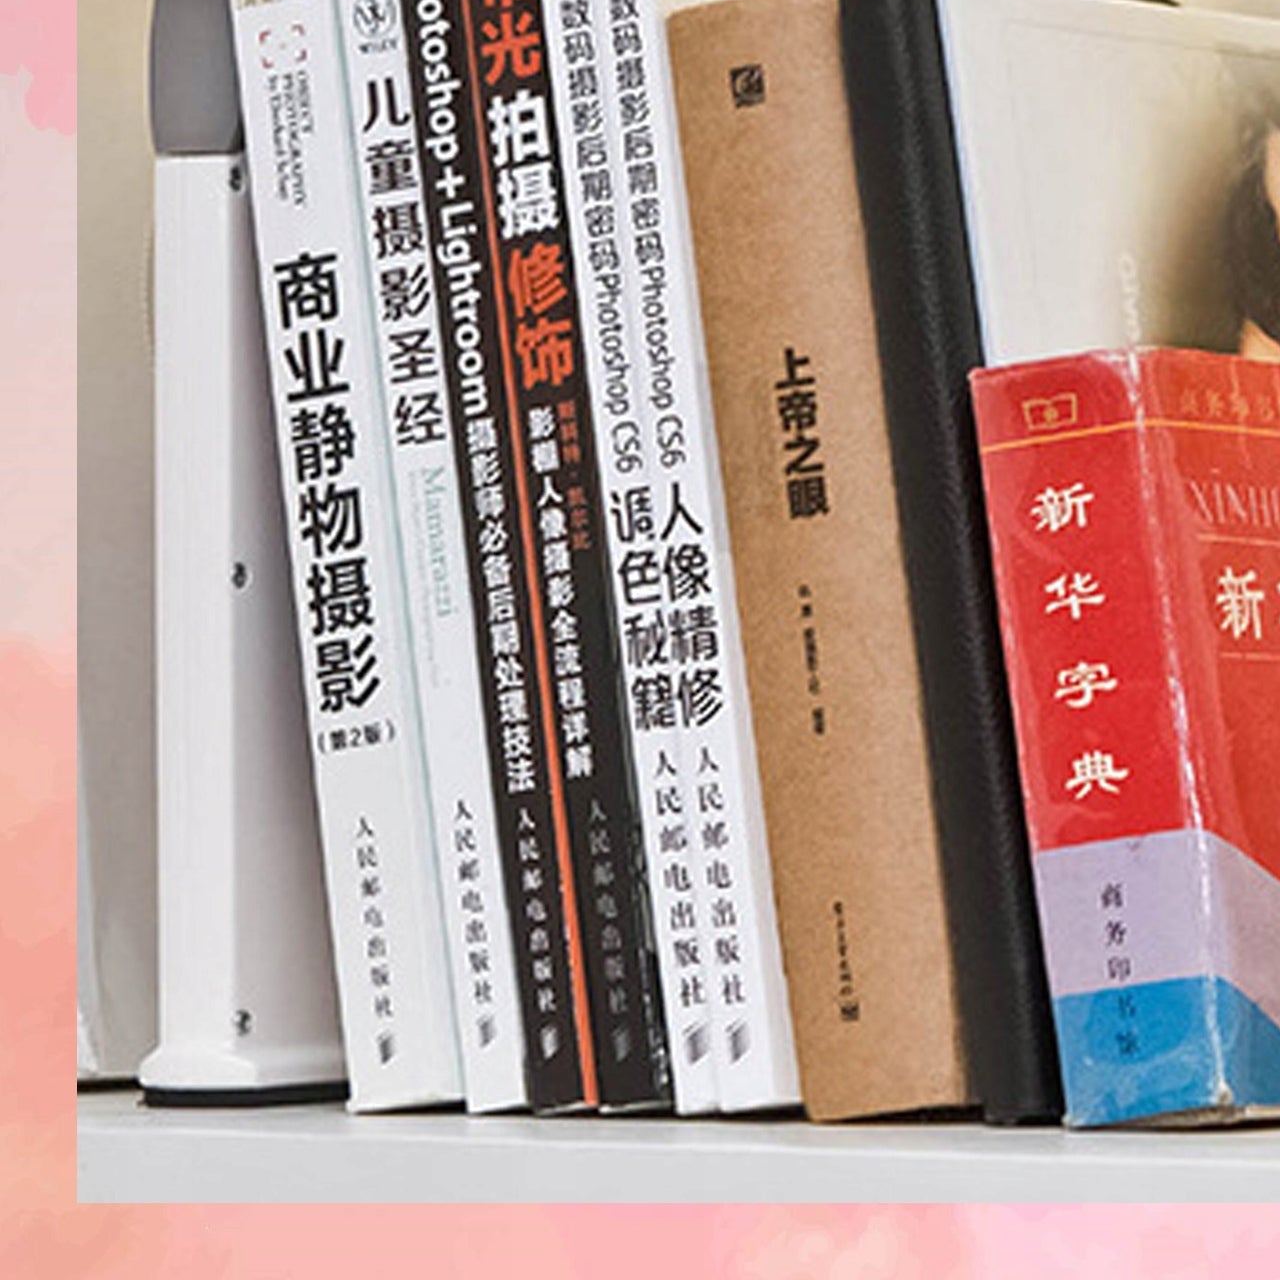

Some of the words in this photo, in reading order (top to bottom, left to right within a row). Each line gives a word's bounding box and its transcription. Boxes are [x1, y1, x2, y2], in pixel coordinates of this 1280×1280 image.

[363, 76, 446, 447] 儿童摄影圣经
[273, 251, 380, 713] 商业静物摄影
[610, 421, 644, 474] CS6
[654, 416, 687, 470] CS6
[774, 347, 830, 519] 上帝之眼
[610, 486, 676, 731] 调色秘籍
[660, 482, 724, 727] 人像精修
[1030, 482, 1130, 800] 新华字典
[355, 815, 394, 1019] 人民邮电出版社
[455, 799, 493, 1005] 人民邮电出版社
[518, 807, 557, 1013] 人民邮电出版社
[589, 800, 629, 1013] 人民邮电出版社
[653, 749, 704, 1008] 人民邮电出版社
[696, 746, 746, 1006] 人民邮电出版社
